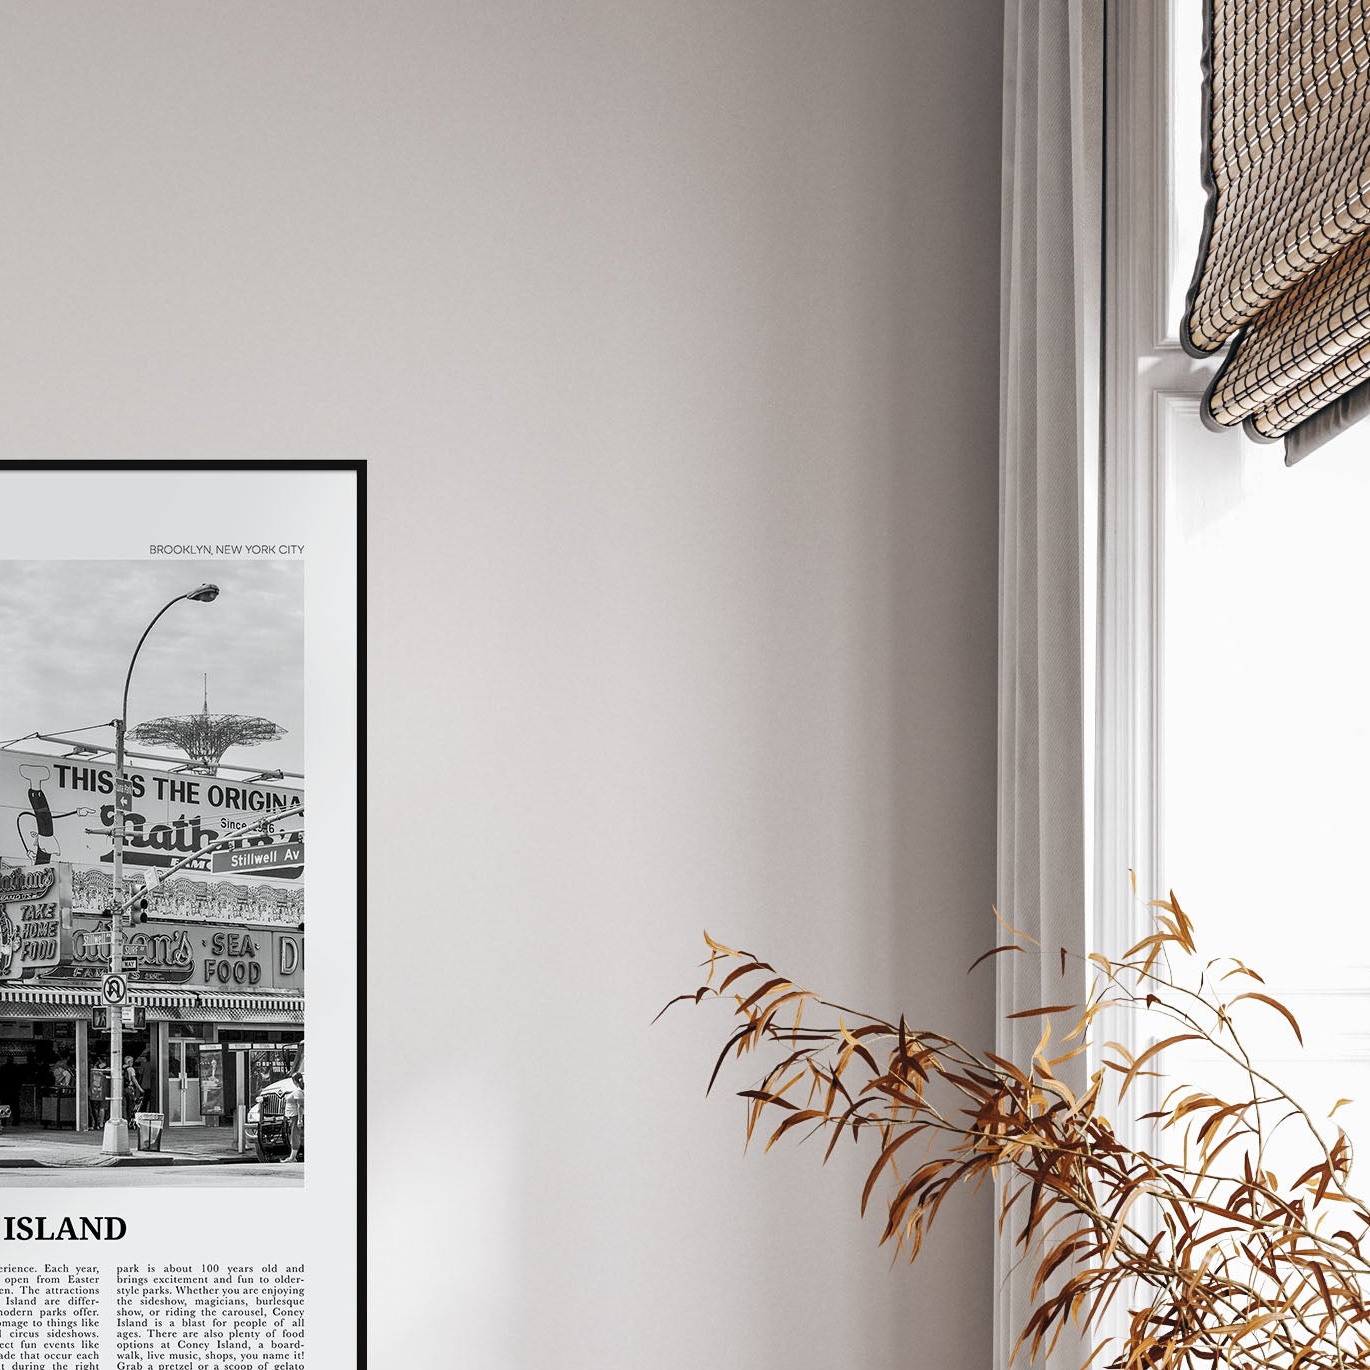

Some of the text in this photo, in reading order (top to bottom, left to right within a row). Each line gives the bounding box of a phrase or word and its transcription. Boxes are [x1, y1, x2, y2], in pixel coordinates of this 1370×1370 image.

[150, 544, 304, 555] BROOKLYN, NEW YORK CITY
[53, 764, 114, 795] THIS
[152, 777, 200, 804] THE
[220, 818, 247, 830] Since
[230, 849, 300, 868] Stillwell Av
[20, 903, 57, 921] TAKE
[23, 921, 59, 939] HOME
[20, 938, 57, 962] FOOD
[212, 933, 256, 958] SEA
[204, 959, 262, 984] FOOD
[4, 1216, 127, 1240] ISLAND
[44, 1264, 69, 1273] Each
[75, 1266, 100, 1275] year,
[116, 1264, 305, 1275] park is about 100 years old and
[116, 1275, 305, 1286] brings excitement and fun to older-
[19, 1286, 40, 1295] The
[45, 1286, 100, 1295] attractions
[116, 1297, 305, 1308] the sideshow, magicians, burlesque
[116, 1308, 144, 1319] show,
[165, 1308, 196, 1319] riding
[200, 1308, 217, 1316] the
[221, 1308, 267, 1319] carousel,
[272, 1308, 305, 1319] Coney
[32, 1318, 43, 1327] to
[46, 1318, 78, 1330] things
[81, 1318, 100, 1327] like
[116, 1340, 154, 1351] options
[160, 1340, 171, 1349] at
[177, 1340, 210, 1351] Coney
[217, 1340, 252, 1351] Island,
[271, 1340, 305, 1349] board-
[20, 1351, 40, 1360] that
[76, 1351, 100, 1360] each
